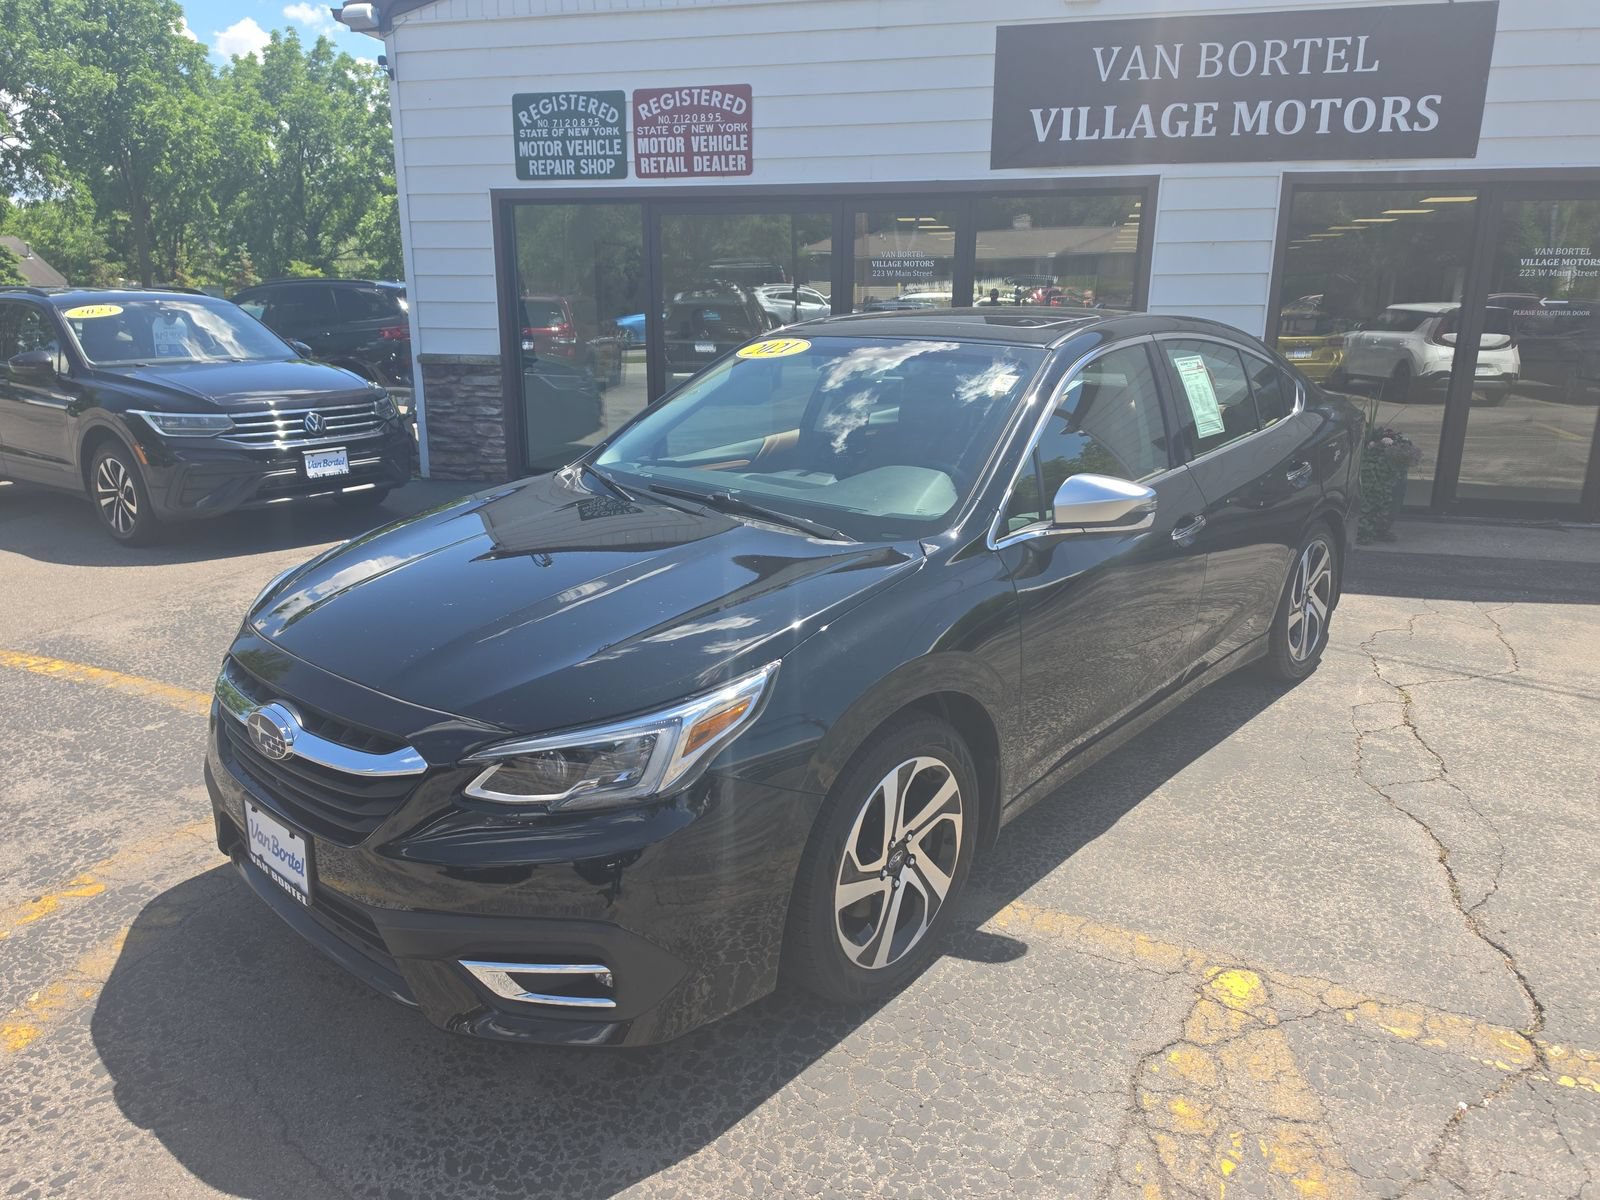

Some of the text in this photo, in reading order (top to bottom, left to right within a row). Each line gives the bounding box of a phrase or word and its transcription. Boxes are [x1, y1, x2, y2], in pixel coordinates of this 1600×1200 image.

[1093, 35, 1379, 82] VAN BORTEL
[518, 94, 619, 127] REGISTERED
[638, 89, 747, 121] REGISTERED
[552, 118, 600, 128] 7120895
[673, 112, 721, 124] 7120895
[1029, 95, 1442, 142] VILLAGE MOTORS
[520, 126, 620, 138] STATE OF NEW YORK
[637, 122, 748, 136] STATE OF NEW YORK
[519, 139, 622, 157] MOTOR VEHICLE
[637, 134, 748, 154] MOTOR VEHICLE
[528, 158, 615, 176] REPAIR SHOP
[640, 154, 746, 174] RETAIL DEALER
[897, 250, 926, 258] BORTEL
[1534, 247, 1592, 256] VAN BORTEL
[1520, 258, 1600, 266] VILLAGE MOTORS
[895, 269, 911, 277] Main
[912, 269, 933, 277] Street
[1519, 268, 1598, 277] 223 W Main Street
[744, 342, 801, 355] 2021
[271, 835, 305, 878] Bortel
[250, 853, 309, 907] VAN BORTEL
